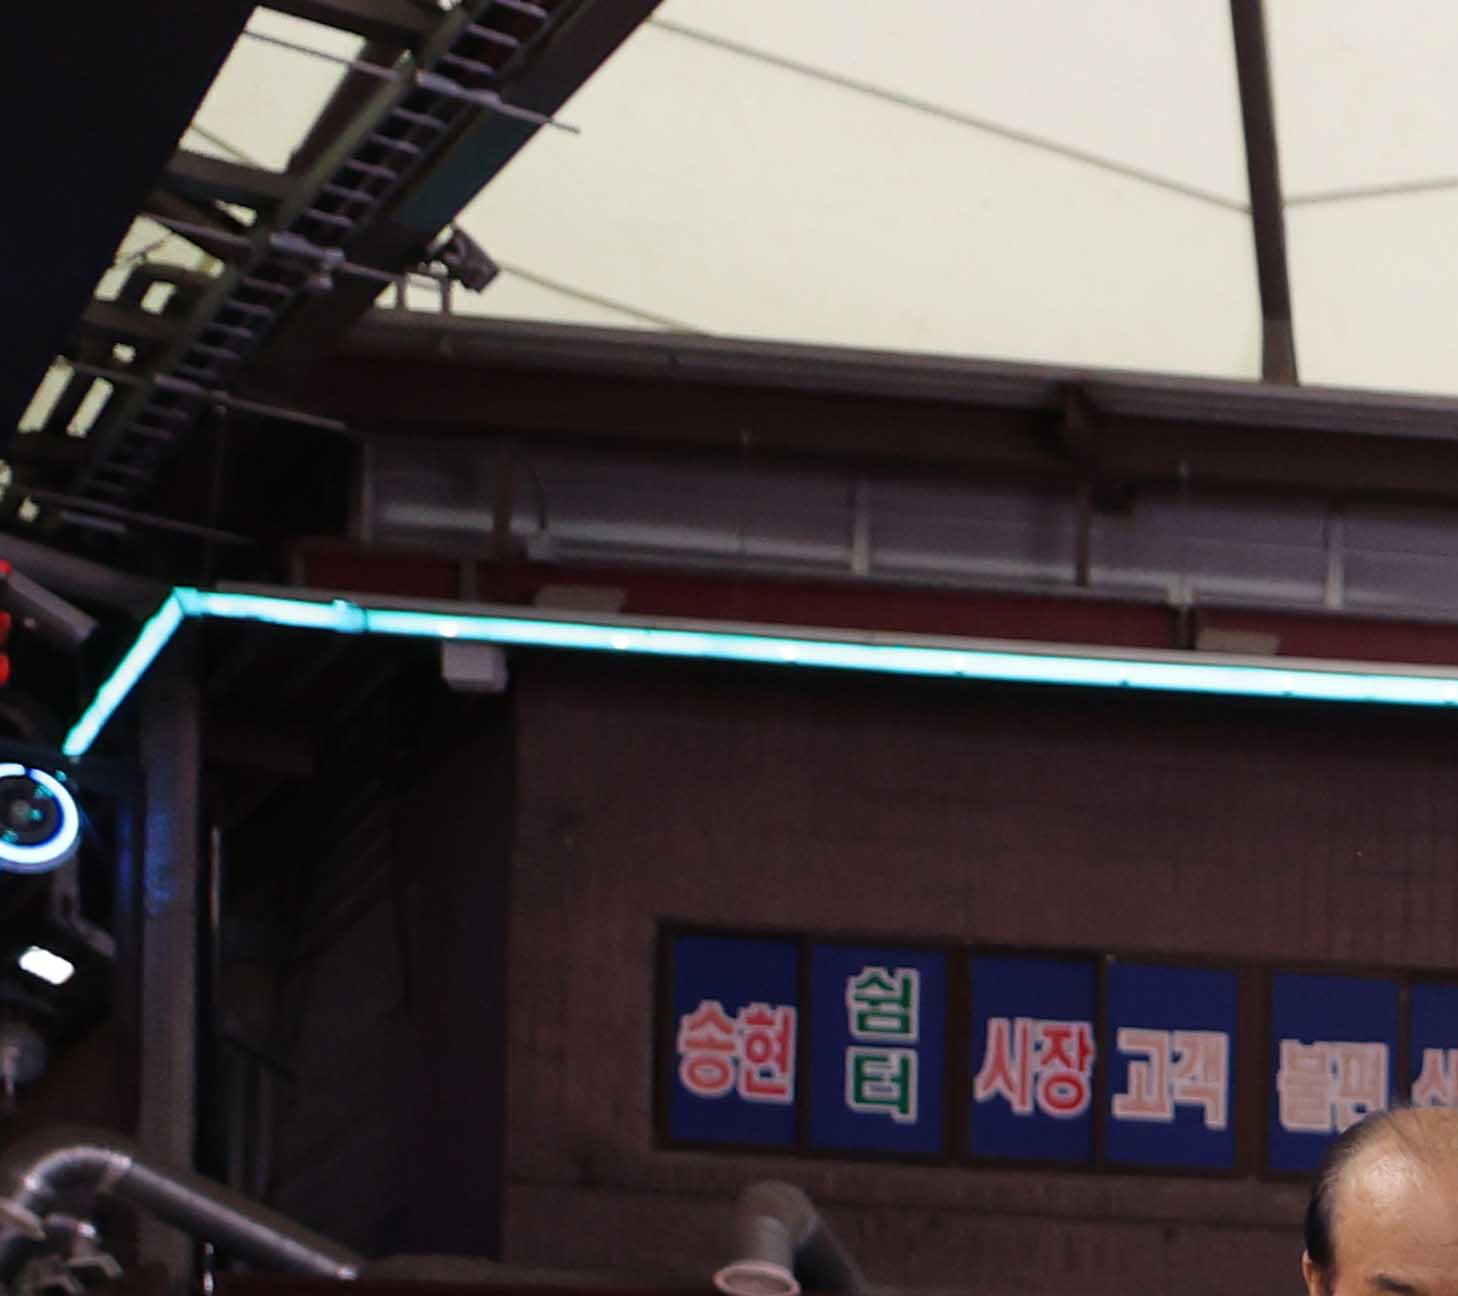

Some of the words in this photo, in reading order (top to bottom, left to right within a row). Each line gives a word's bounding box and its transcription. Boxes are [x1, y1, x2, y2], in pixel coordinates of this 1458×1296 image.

[678, 1000, 796, 1103] 송현
[845, 965, 921, 1124] 쉼터
[973, 1013, 1096, 1117] 시장
[1112, 1026, 1231, 1129] 고객
